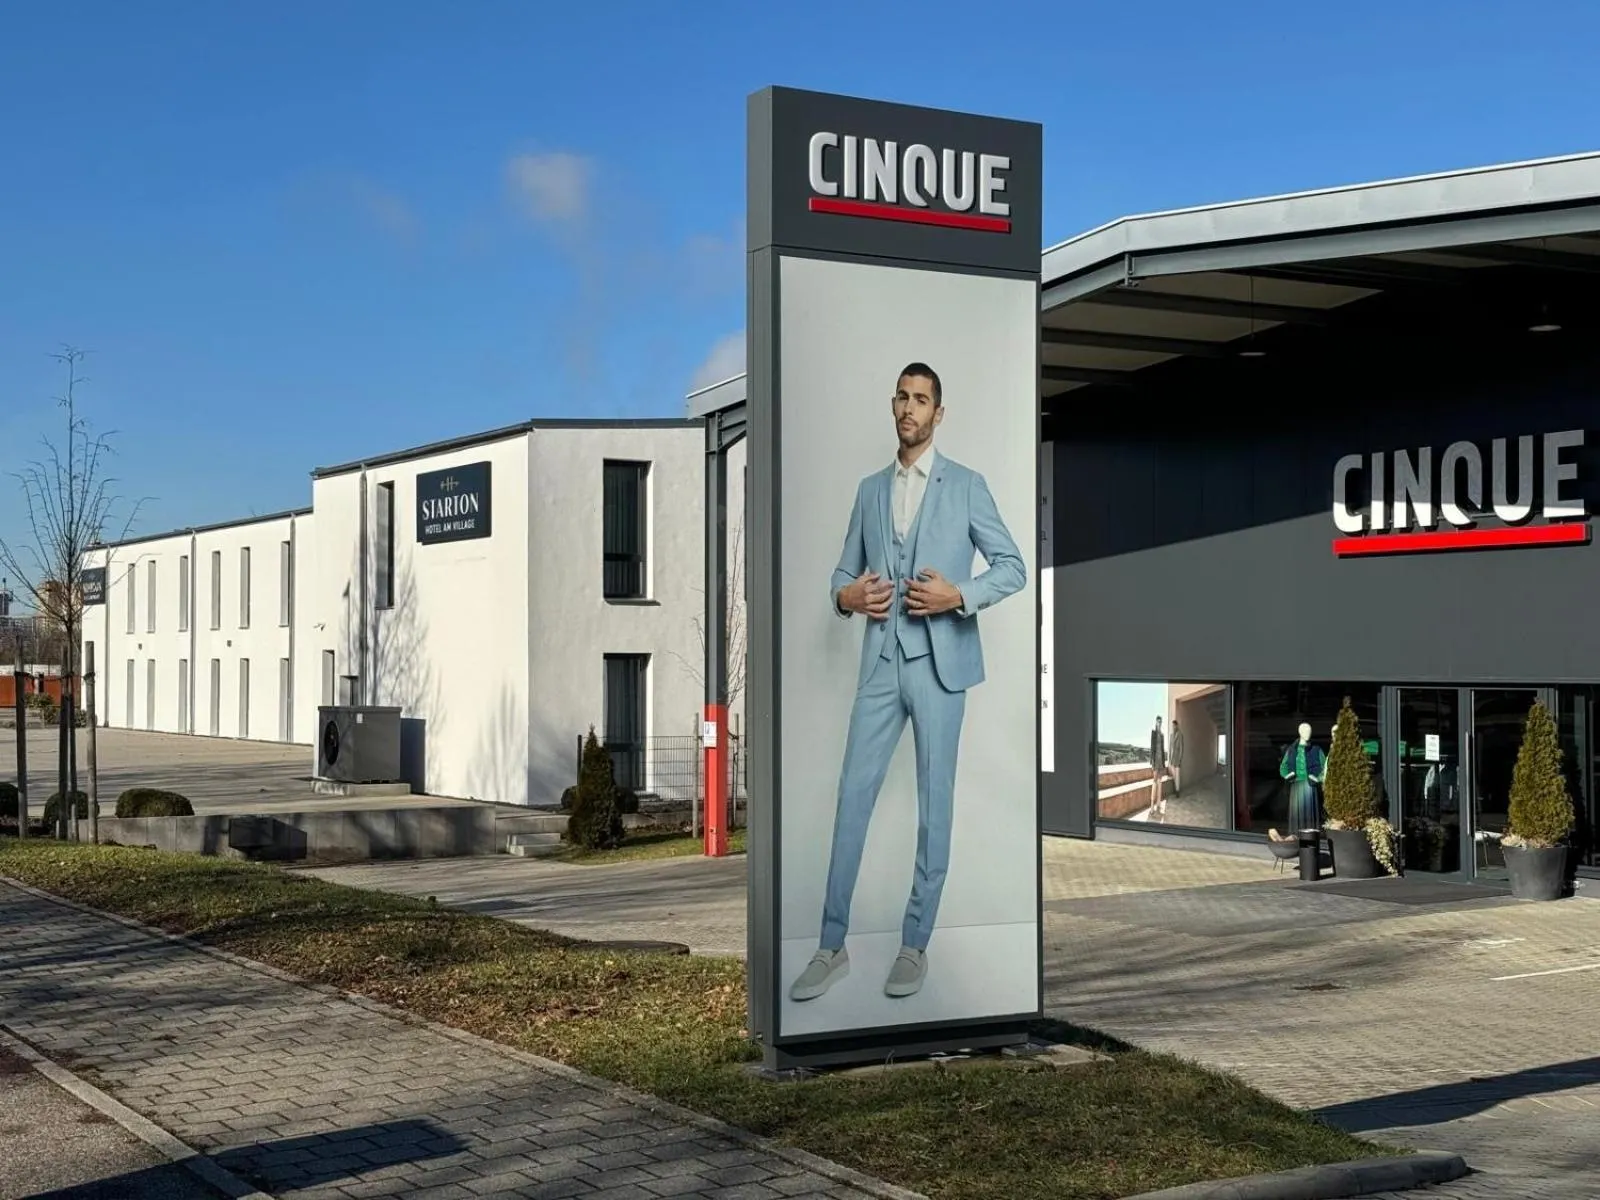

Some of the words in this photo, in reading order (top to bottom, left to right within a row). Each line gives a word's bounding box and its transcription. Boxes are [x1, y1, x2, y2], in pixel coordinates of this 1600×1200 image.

[808, 131, 1011, 216] CINQUE
[422, 492, 479, 521] STARTON
[1332, 429, 1585, 533] CINQUE
[425, 523, 442, 535] HOTEL
[443, 521, 452, 532] AM
[453, 518, 475, 530] VILLAGE
